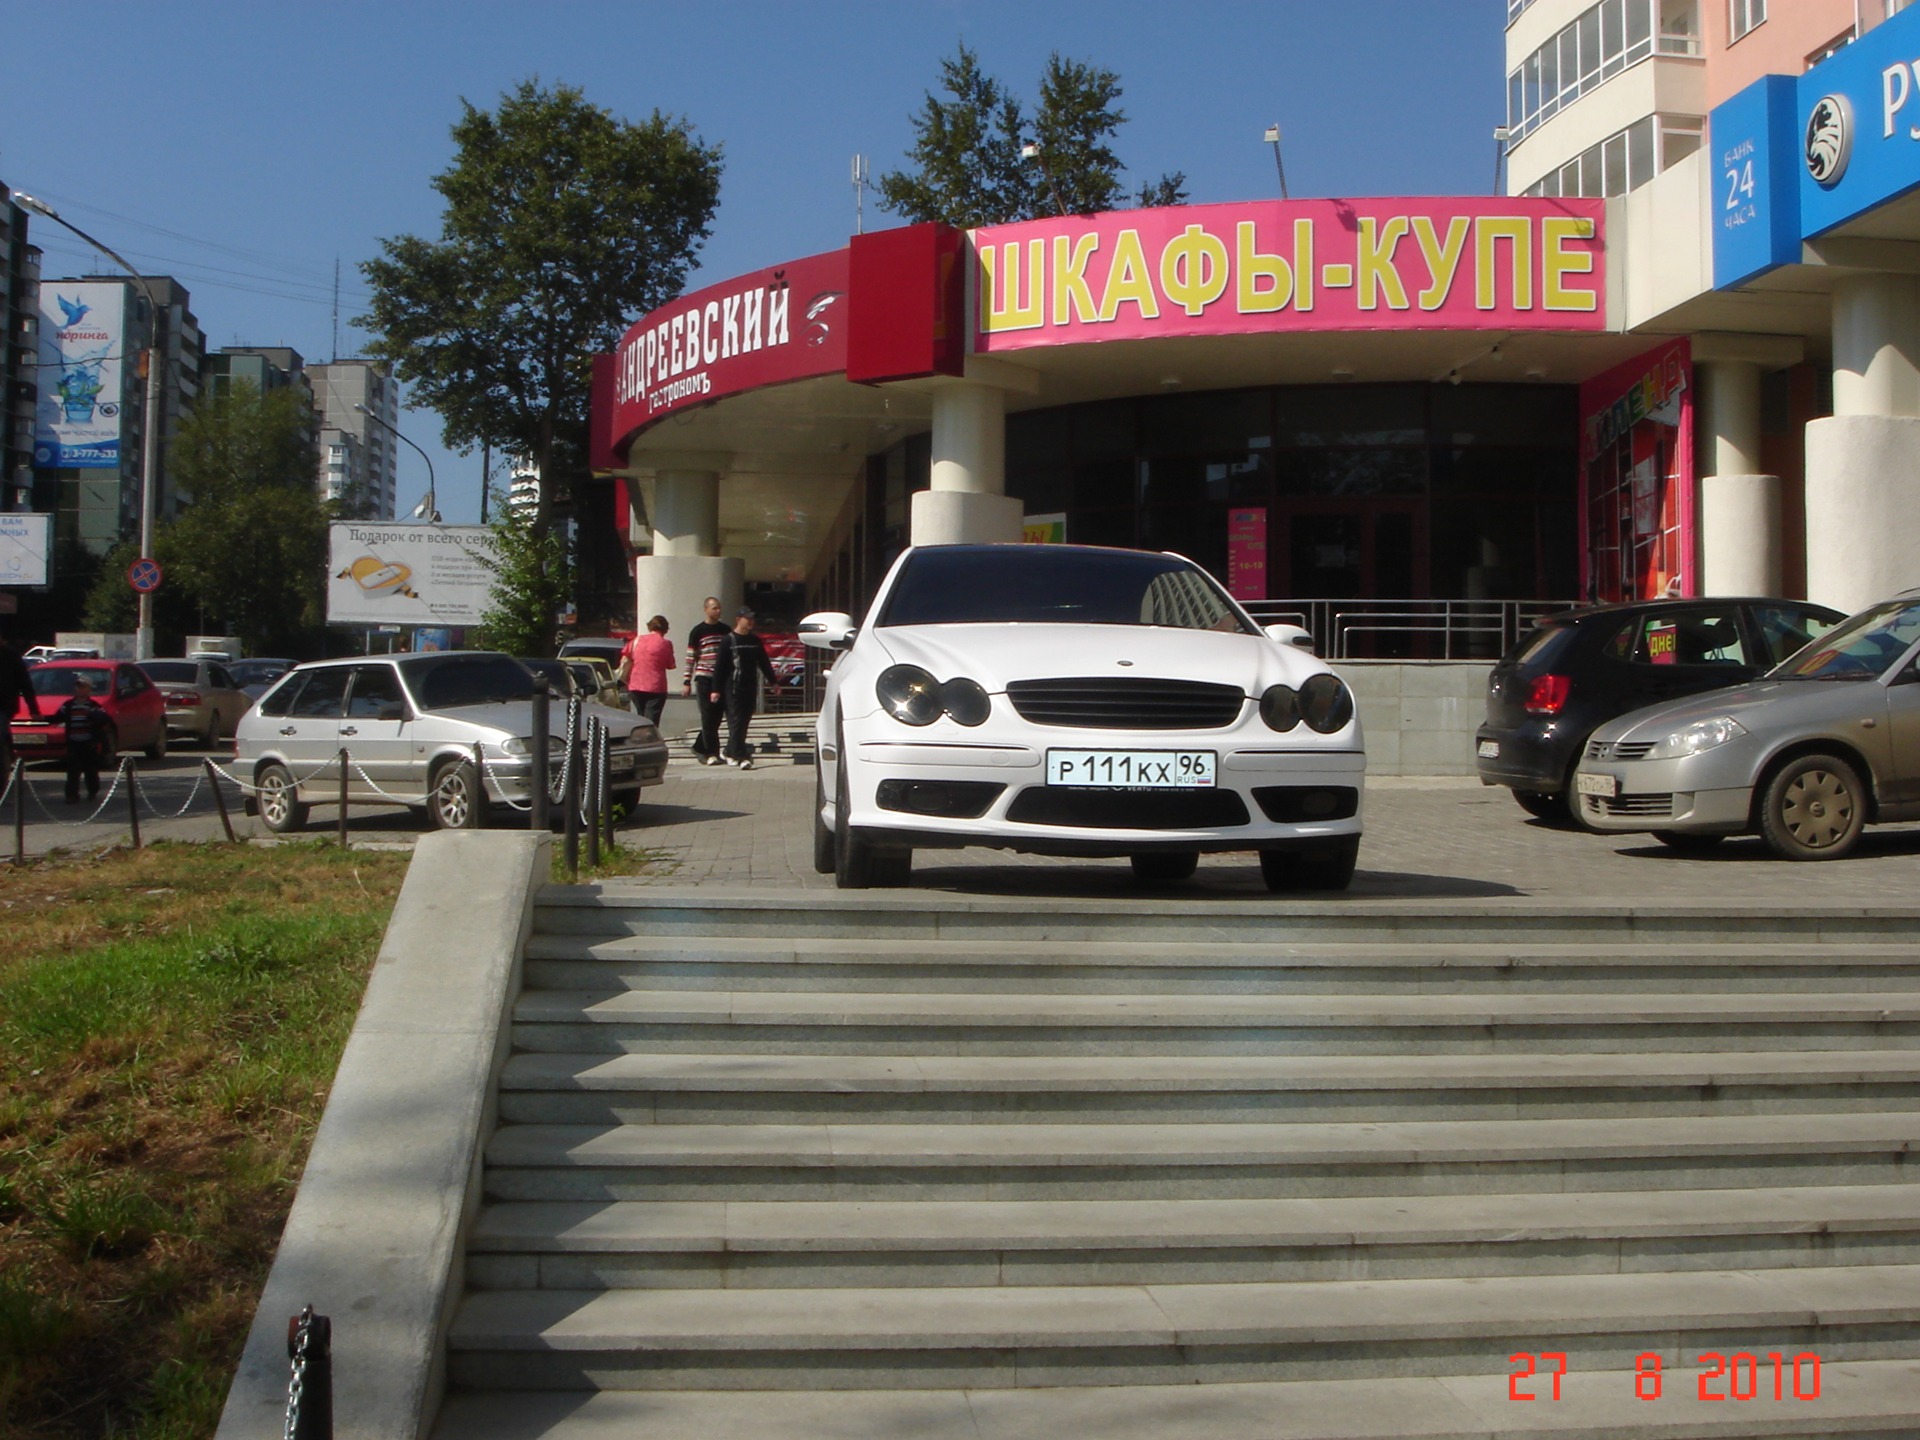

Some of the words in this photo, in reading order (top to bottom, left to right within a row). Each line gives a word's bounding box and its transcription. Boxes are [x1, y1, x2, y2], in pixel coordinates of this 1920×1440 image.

[1724, 137, 1755, 168] БАНК
[1725, 160, 1755, 212] 24
[1724, 204, 1756, 230] ЧАСА
[980, 215, 1597, 334] ШКАФЫ-КУПЕ
[620, 271, 790, 405] АНДРЕЕВСКИЙ
[350, 529, 405, 544] Подарок
[409, 533, 423, 542] от
[427, 533, 462, 544] всего
[1177, 775, 1197, 784] RUS
[1179, 755, 1205, 776] 96
